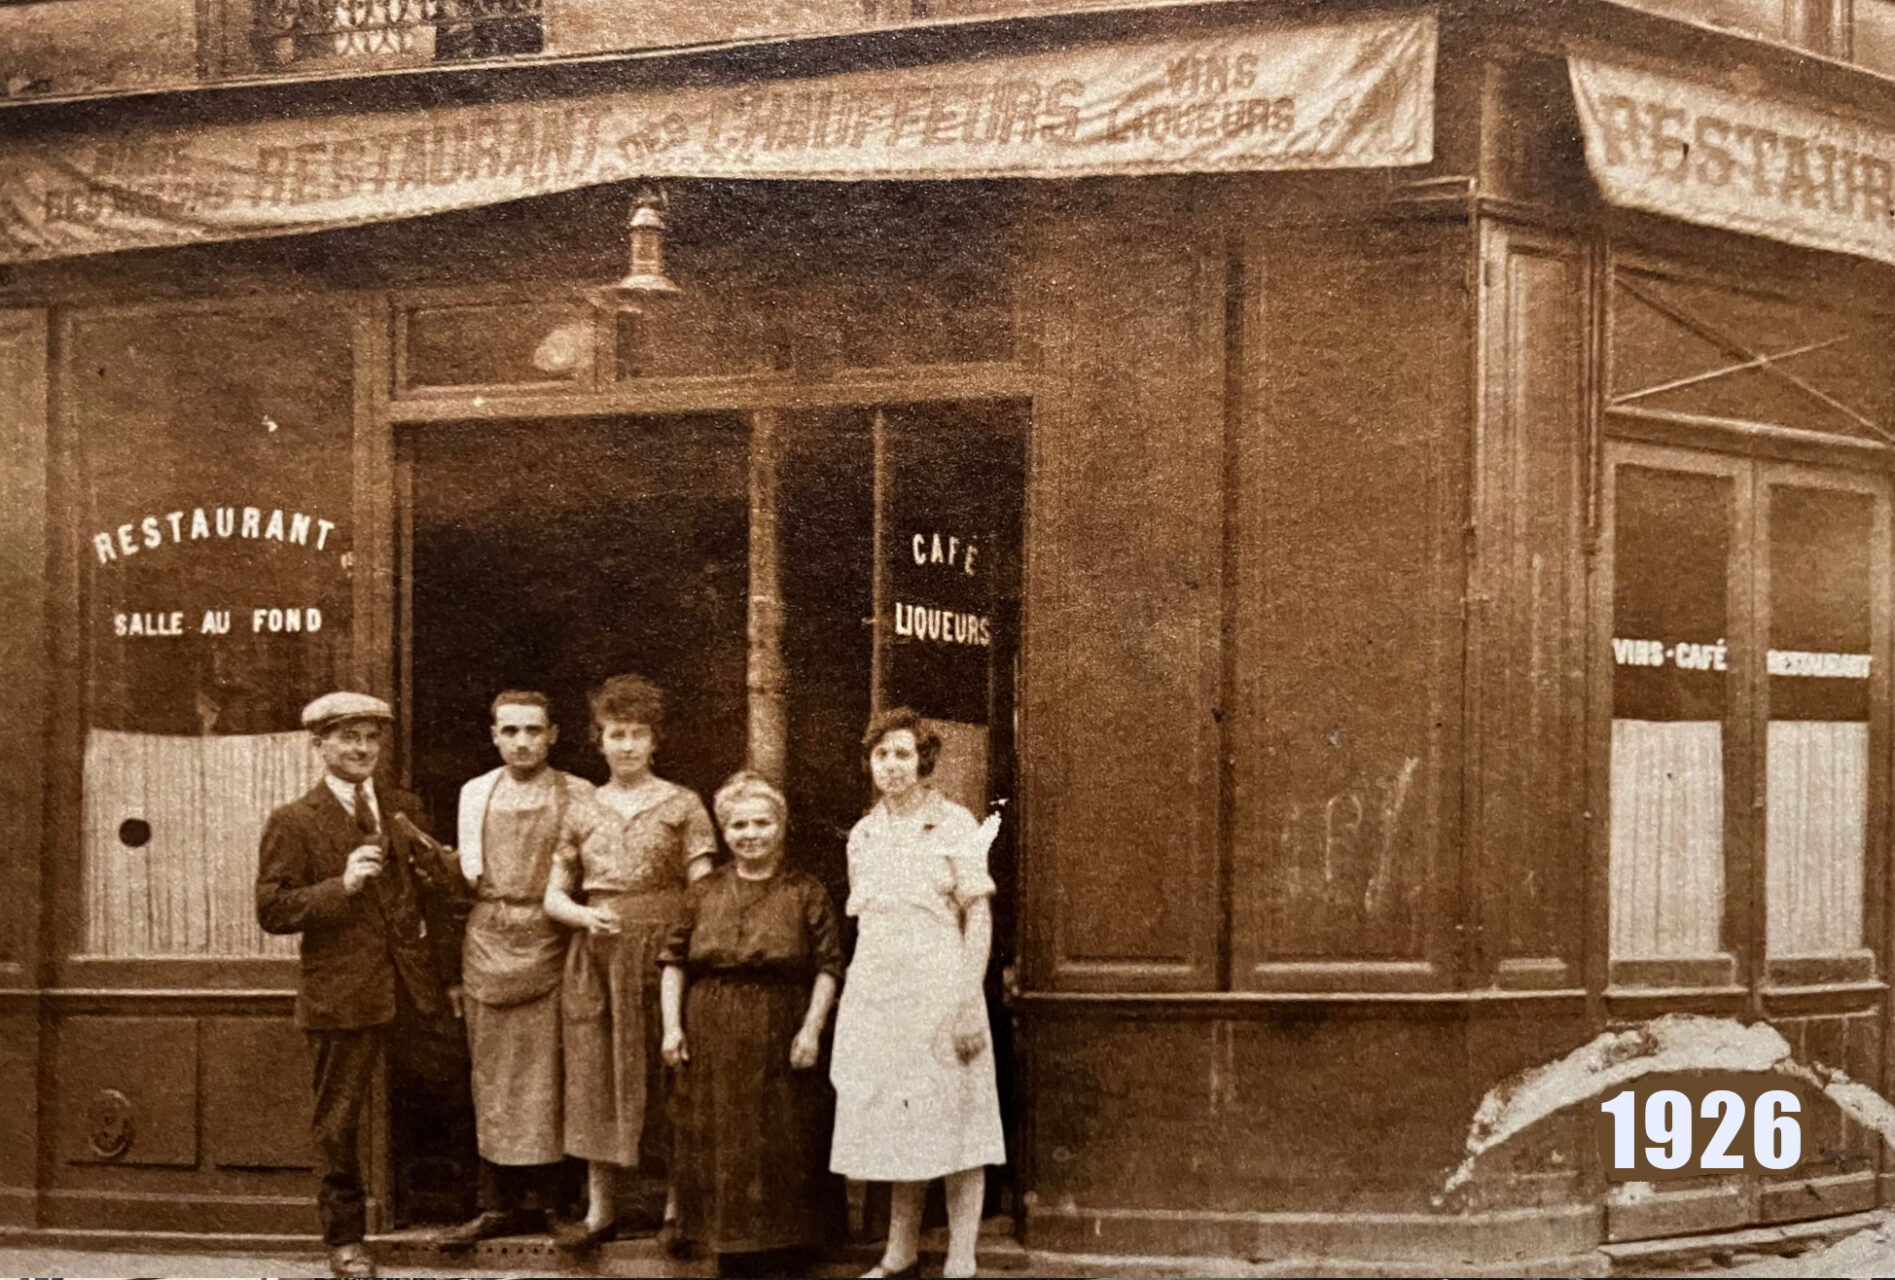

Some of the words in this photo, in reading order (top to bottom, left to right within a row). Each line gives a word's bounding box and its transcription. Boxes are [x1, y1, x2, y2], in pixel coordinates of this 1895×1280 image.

[1165, 52, 1258, 95] VINS
[93, 507, 335, 564] RESTAURANT
[114, 612, 184, 636] SALLE
[201, 611, 230, 634] AU
[253, 608, 322, 633] FOND
[895, 602, 991, 647] LIQUEURS
